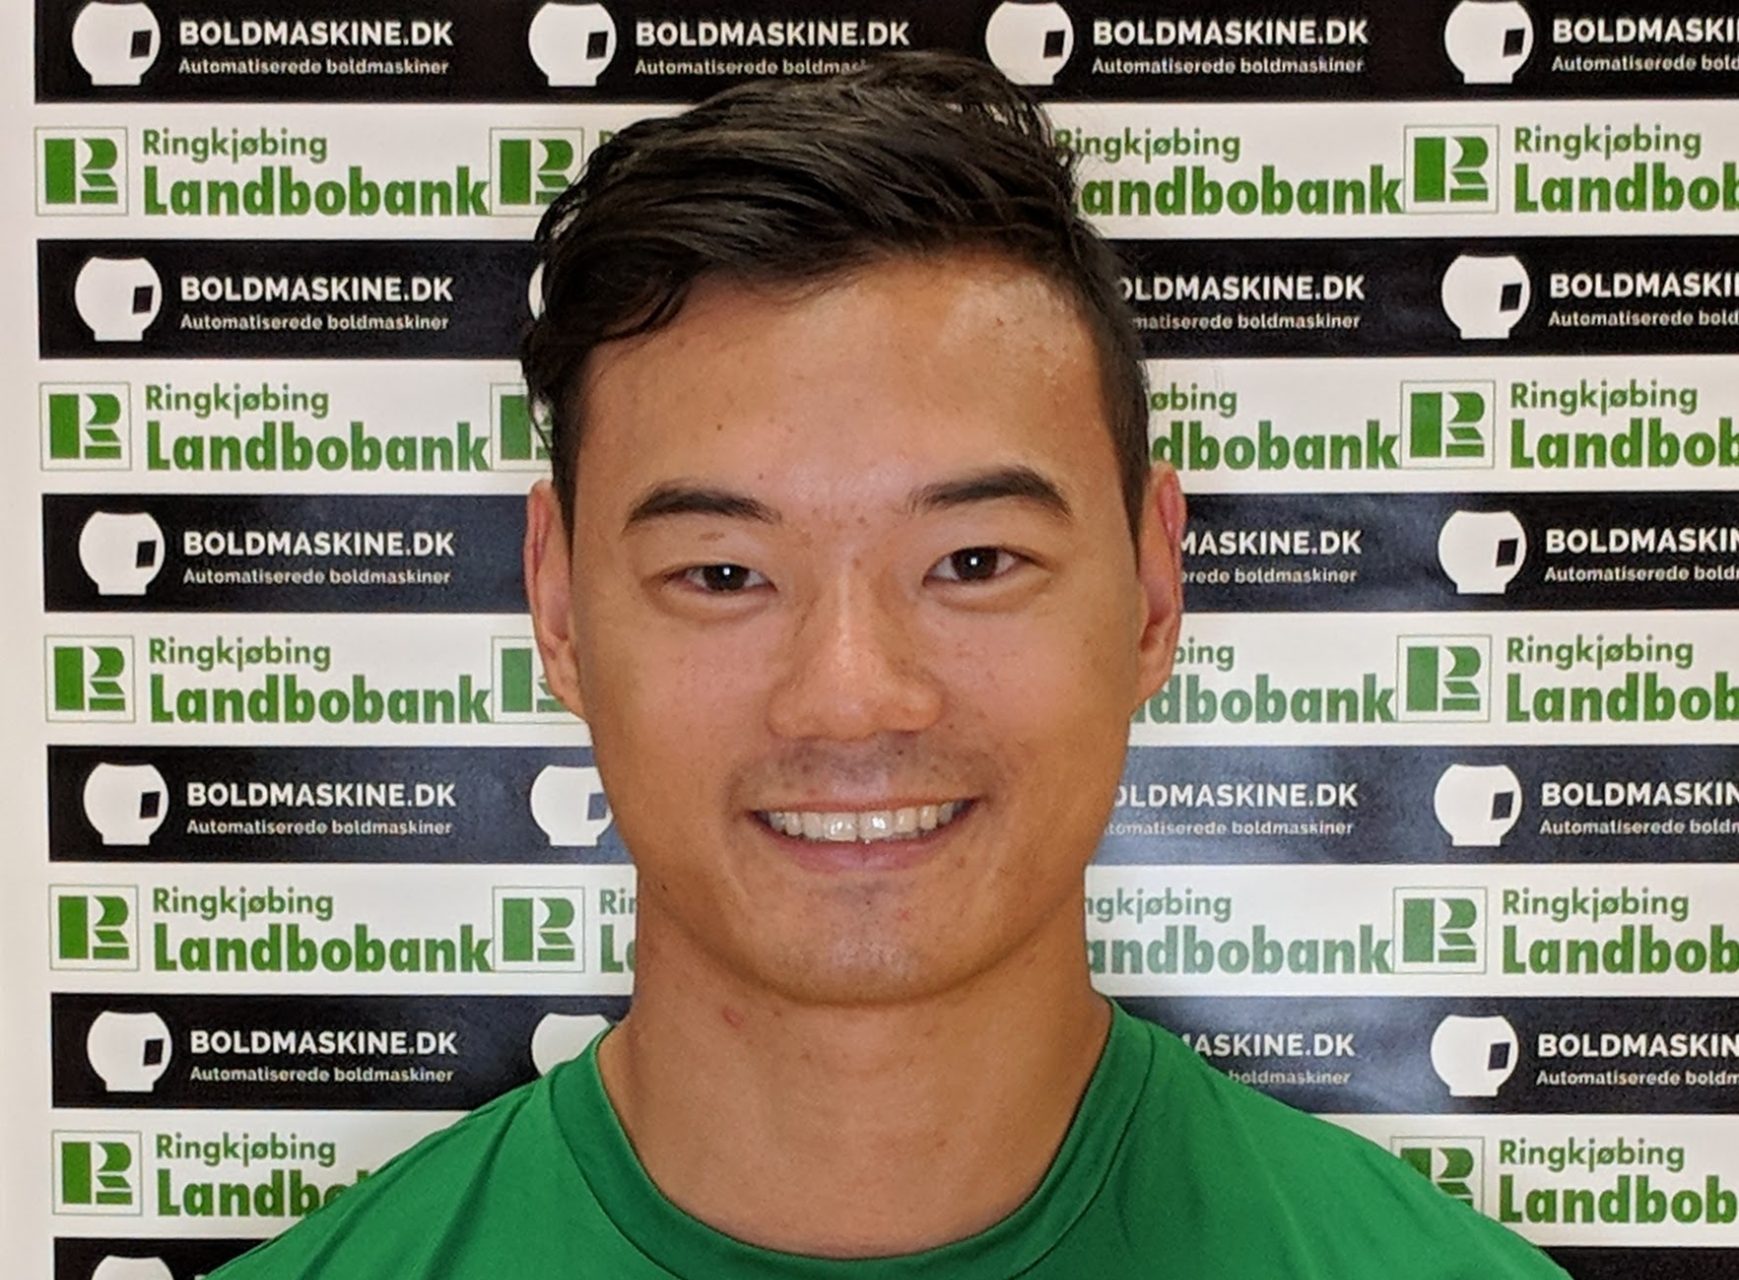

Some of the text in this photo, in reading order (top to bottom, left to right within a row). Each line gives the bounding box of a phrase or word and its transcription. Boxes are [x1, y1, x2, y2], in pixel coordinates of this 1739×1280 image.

[180, 21, 452, 45] BOLDMASKINE.DK
[637, 22, 909, 46] BOLDMASKINE.DK
[1094, 20, 1367, 45] BOLDMASKINE.DK
[1553, 18, 1739, 42] BOLDMASKI
[179, 58, 448, 74] Automatiserede boldmaskiner
[635, 59, 778, 74] Automatiserede
[1093, 58, 1362, 73] Automatiserede boldmaskiner
[1552, 55, 1696, 71] Automatiserede
[143, 127, 327, 163] Ringkjøbing
[1055, 127, 1241, 163] Ringkjøbing
[1515, 124, 1701, 160] Ringkjøbing
[144, 166, 488, 216] Landbobank
[1080, 165, 1401, 215] andbobank
[181, 277, 452, 301] BOLDMASKINE.DK
[1122, 276, 1364, 300] OLDMASKINE.DK
[1551, 273, 1739, 298] BOLDMASKI
[181, 314, 448, 330] Automatiserede boldmaskiner
[1134, 313, 1359, 329] matiserede boldmaskiner
[1549, 310, 1693, 326] Automatiserede
[146, 383, 328, 419] Ringkjøbing
[1511, 379, 1697, 416] Ringkjøbing
[147, 421, 488, 471] Landbobank
[1152, 420, 1398, 470] dbobank
[1511, 418, 1739, 468] Landbob
[185, 532, 454, 556] BOLDMASKINE.DK
[1181, 531, 1361, 555] MASKINE.DK
[184, 568, 450, 584] Automatiserede boldmaskiner
[1235, 568, 1356, 583] boldmaskiner
[1545, 565, 1739, 581] Automatiserede bold
[150, 636, 330, 672] Ringkjøbing
[1508, 634, 1693, 670] Ringkjøbing
[151, 674, 490, 723] Landbobank
[1133, 674, 1395, 723] dbobank
[1507, 672, 1739, 721] Landbob
[188, 783, 456, 806] BOLDMASKINE.DK
[187, 820, 452, 834] Automatiserede boldmaskiner
[1106, 820, 1352, 835] tomatiserede boldmaskiner
[1540, 819, 1685, 834] Automatiserede
[154, 886, 333, 921] Ringkjøbing
[1503, 887, 1688, 922] Ringkjøbing
[154, 923, 491, 972] Landbobank
[1088, 925, 1391, 974] andbobank
[1503, 925, 1739, 973] Landbob
[191, 1031, 457, 1054] BOLDMASKINE.DK
[1188, 1033, 1355, 1057] ASKINE.DK
[191, 1067, 453, 1082] Automatiserede boldmaskiner
[1537, 1070, 1680, 1085] Automatiserede
[157, 1132, 335, 1168] Ringkjøbing
[1500, 1137, 1684, 1172] Ringkjøbing
[157, 1169, 369, 1217] Landb
[1501, 1175, 1737, 1223] Landbob
